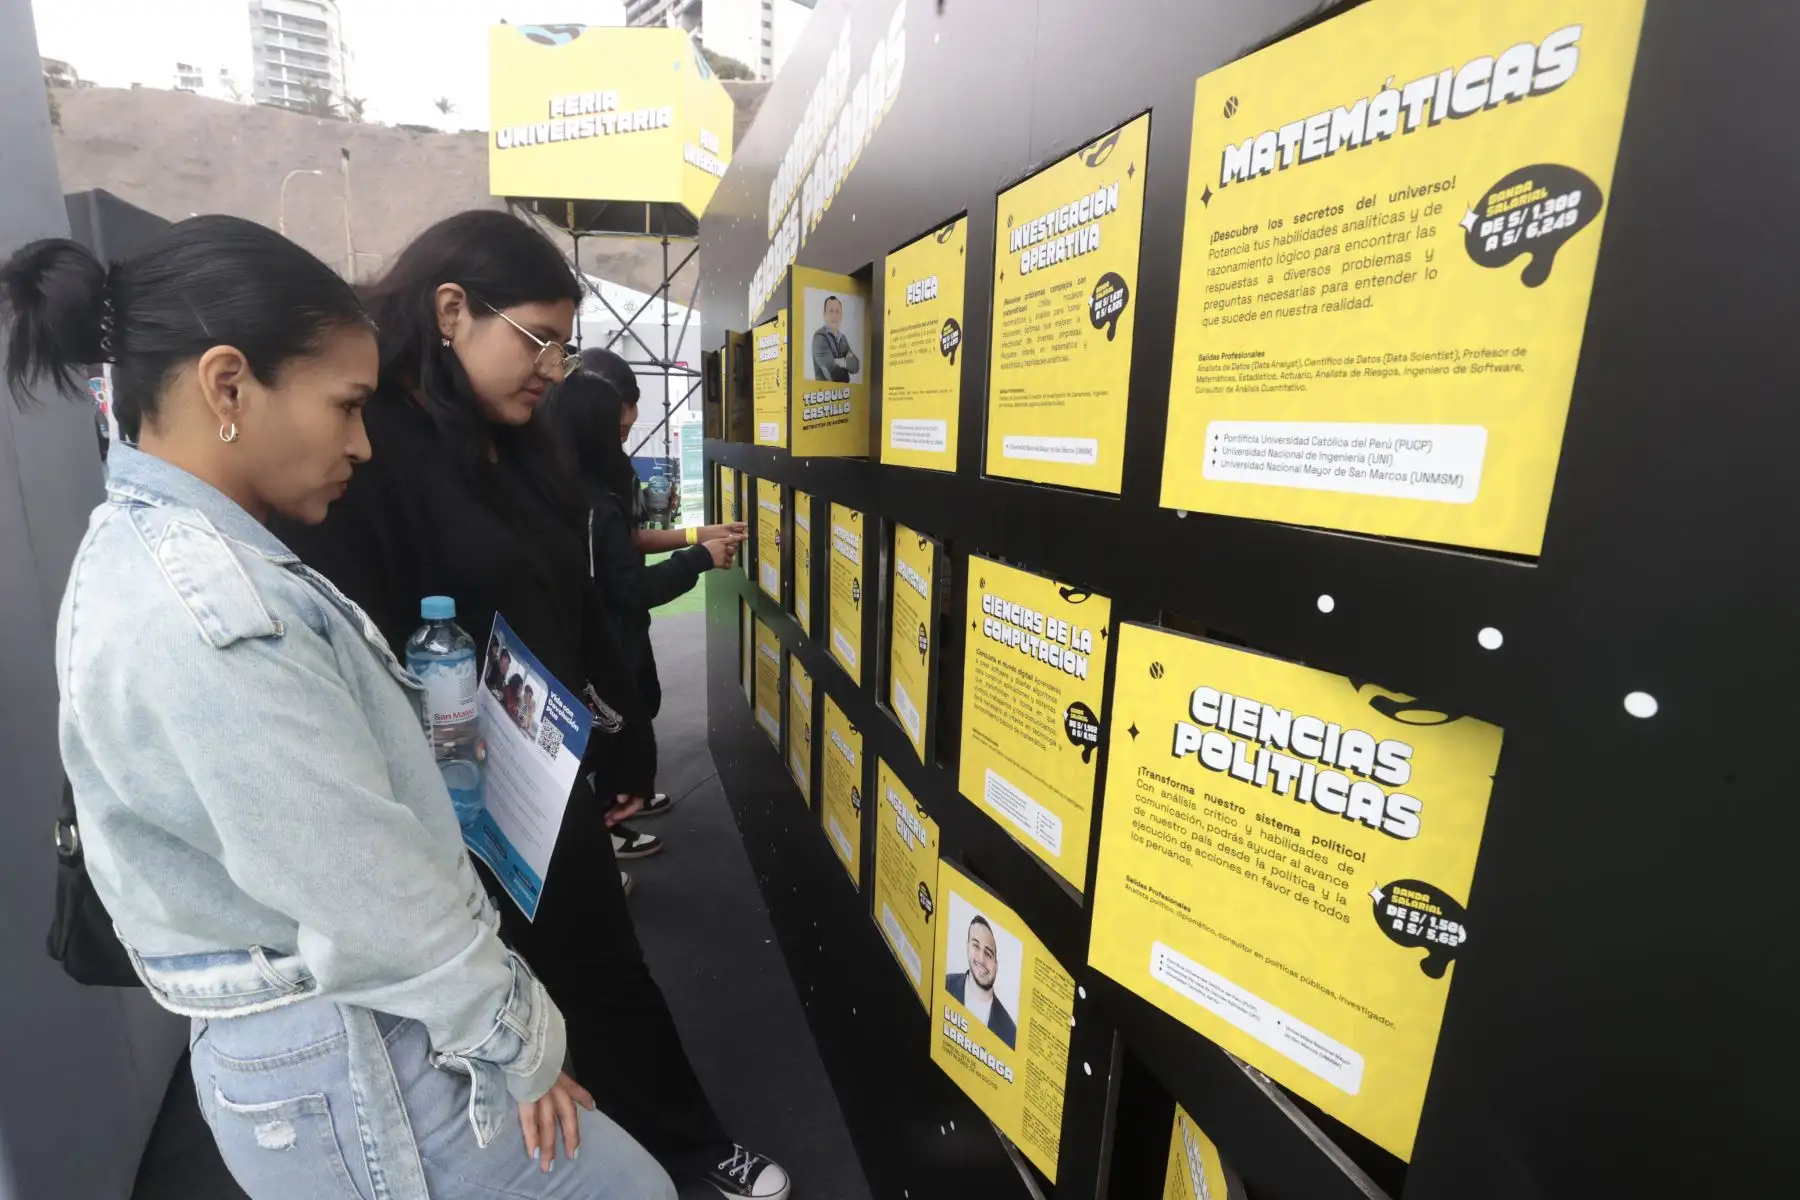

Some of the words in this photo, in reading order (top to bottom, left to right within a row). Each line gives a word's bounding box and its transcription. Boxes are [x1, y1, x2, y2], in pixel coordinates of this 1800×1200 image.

[496, 106, 672, 149] UNIVERSITARIA
[549, 90, 618, 119] FERIA
[1219, 24, 1584, 188] MATEMÁTICAS
[1009, 181, 1120, 254] INVESTIGACIÓN
[1267, 218, 1283, 230] los
[1292, 204, 1344, 224] secretos
[1355, 194, 1376, 210] del
[1388, 175, 1456, 203] universo!
[1480, 216, 1505, 237] DE
[1508, 207, 1529, 228] S/
[1019, 223, 1100, 277] OPERATIVA
[1206, 255, 1273, 276] razonamiento
[1276, 249, 1310, 266] lógico
[1313, 243, 1340, 260] para
[1344, 230, 1411, 252] encontrar
[1415, 224, 1436, 240] las
[1208, 241, 1250, 260] Potencia
[1253, 239, 1270, 251] tus
[1272, 224, 1338, 247] habilidades
[1341, 210, 1405, 233] analíticas
[1409, 208, 1419, 223] y
[1423, 201, 1443, 217] de
[1485, 235, 1499, 252] A
[1502, 227, 1523, 246] S/
[905, 275, 939, 307] FÍSICA
[1203, 294, 1252, 312] preguntas
[1256, 285, 1316, 302] necesarias
[1320, 281, 1348, 296] para
[1354, 270, 1417, 289] entender
[1424, 266, 1438, 280] lo
[1204, 276, 1258, 294] respuestas
[1267, 274, 1273, 284] a
[1283, 264, 1330, 281] diversos
[1341, 251, 1411, 275] problemas
[1424, 248, 1434, 263] y
[1201, 316, 1219, 328] que
[1221, 309, 1257, 324] sucede
[1258, 310, 1272, 320] en
[1275, 303, 1318, 319] nuestra
[1321, 294, 1373, 312] realidad.
[1198, 352, 1220, 361] Salidas
[1220, 350, 1265, 359] Profesionales
[802, 386, 851, 407] TEÓDULO
[803, 401, 851, 421] CASTILLO
[1222, 446, 1266, 457] Universidad
[1267, 448, 1304, 459] Nacional
[1305, 450, 1317, 460] de
[1318, 451, 1365, 463] Ingeniería
[1366, 452, 1393, 467] (UNI)
[1261, 434, 1309, 445] Universidad
[1311, 435, 1349, 447] Católica
[1350, 437, 1367, 448] del
[1368, 437, 1392, 449] Perú
[1394, 438, 1433, 454] (PUCP)
[1220, 459, 1265, 470] Universidad
[1266, 461, 1302, 473] Nacional
[1303, 463, 1331, 477] Mayor
[1334, 465, 1346, 476] de
[1348, 466, 1366, 478] San
[1368, 468, 1407, 481] Marcos
[1410, 471, 1463, 488] (UNMSM)
[981, 593, 1042, 634] CIENCIAS
[1046, 616, 1068, 645] DE
[1071, 626, 1093, 655] LA
[983, 617, 1087, 680] COMPUTACIÓN
[434, 713, 452, 721] San
[1189, 685, 1415, 787] CIENCIAS
[1172, 721, 1424, 841] POLÍTICAS
[1135, 778, 1154, 793] Con
[1160, 790, 1196, 811] análisis
[1203, 807, 1237, 827] crítico
[1245, 824, 1252, 835] y
[1259, 827, 1328, 864] habilidades
[1337, 861, 1354, 875] de
[1137, 765, 1195, 795] ¡Transforma
[1203, 793, 1245, 815] nuestro
[1255, 813, 1300, 837] sistema
[1311, 835, 1365, 863] político!
[1130, 830, 1144, 844] los
[1145, 839, 1193, 867] peruanos.
[1133, 805, 1145, 816] de
[1149, 813, 1187, 835] nuestro
[1190, 831, 1212, 846] país
[1217, 841, 1250, 863] desde
[1255, 857, 1265, 870] la
[1270, 866, 1316, 892] política
[1321, 888, 1329, 900] y
[1335, 891, 1347, 906] la
[1135, 793, 1204, 829] comunicación,
[1206, 823, 1244, 845] podrás
[1246, 840, 1287, 862] ayudar
[1289, 858, 1300, 868] al
[1303, 864, 1349, 889] avance
[1132, 819, 1177, 845] ejecución
[1179, 840, 1192, 852] de
[1194, 847, 1241, 875] acciones
[1244, 870, 1258, 881] en
[1261, 875, 1291, 896] favor
[1293, 891, 1309, 904] de
[1313, 899, 1350, 923] todos
[1386, 904, 1408, 919] DE
[1409, 910, 1427, 924] S/
[1392, 918, 1404, 931] A
[1406, 922, 1424, 936] S/
[944, 1004, 969, 1034] LUIS
[942, 1021, 1015, 1085] LARRAÑAGA
